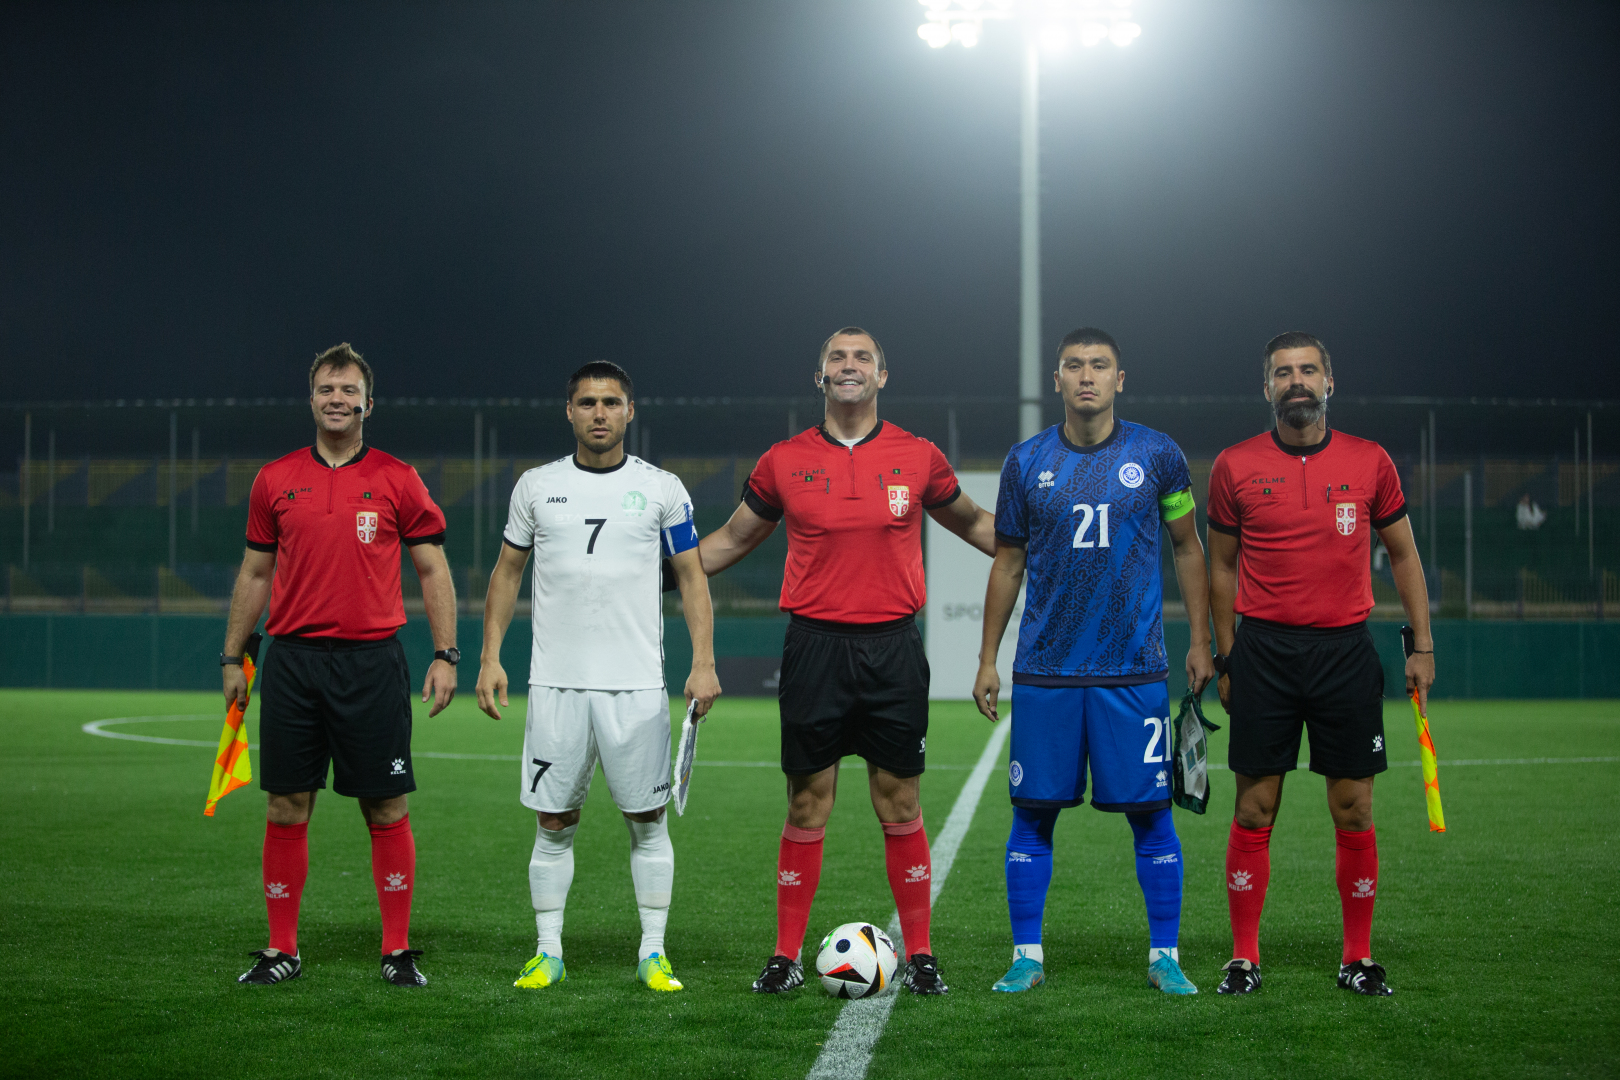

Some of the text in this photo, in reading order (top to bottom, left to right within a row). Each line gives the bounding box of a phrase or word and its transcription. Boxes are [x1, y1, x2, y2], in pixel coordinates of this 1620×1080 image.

[791, 468, 826, 477] KELME
[1252, 477, 1286, 485] KELME
[282, 487, 313, 496] KELME
[546, 496, 568, 504] JAKO
[1072, 503, 1111, 549] 21
[584, 518, 608, 555] 7
[1143, 716, 1172, 764] 21
[530, 757, 553, 794] 7
[652, 782, 669, 794] JAKO
[905, 873, 930, 883] KELME
[384, 884, 408, 892] KELME
[1228, 882, 1253, 891] KELME
[1352, 889, 1375, 898] KELME
